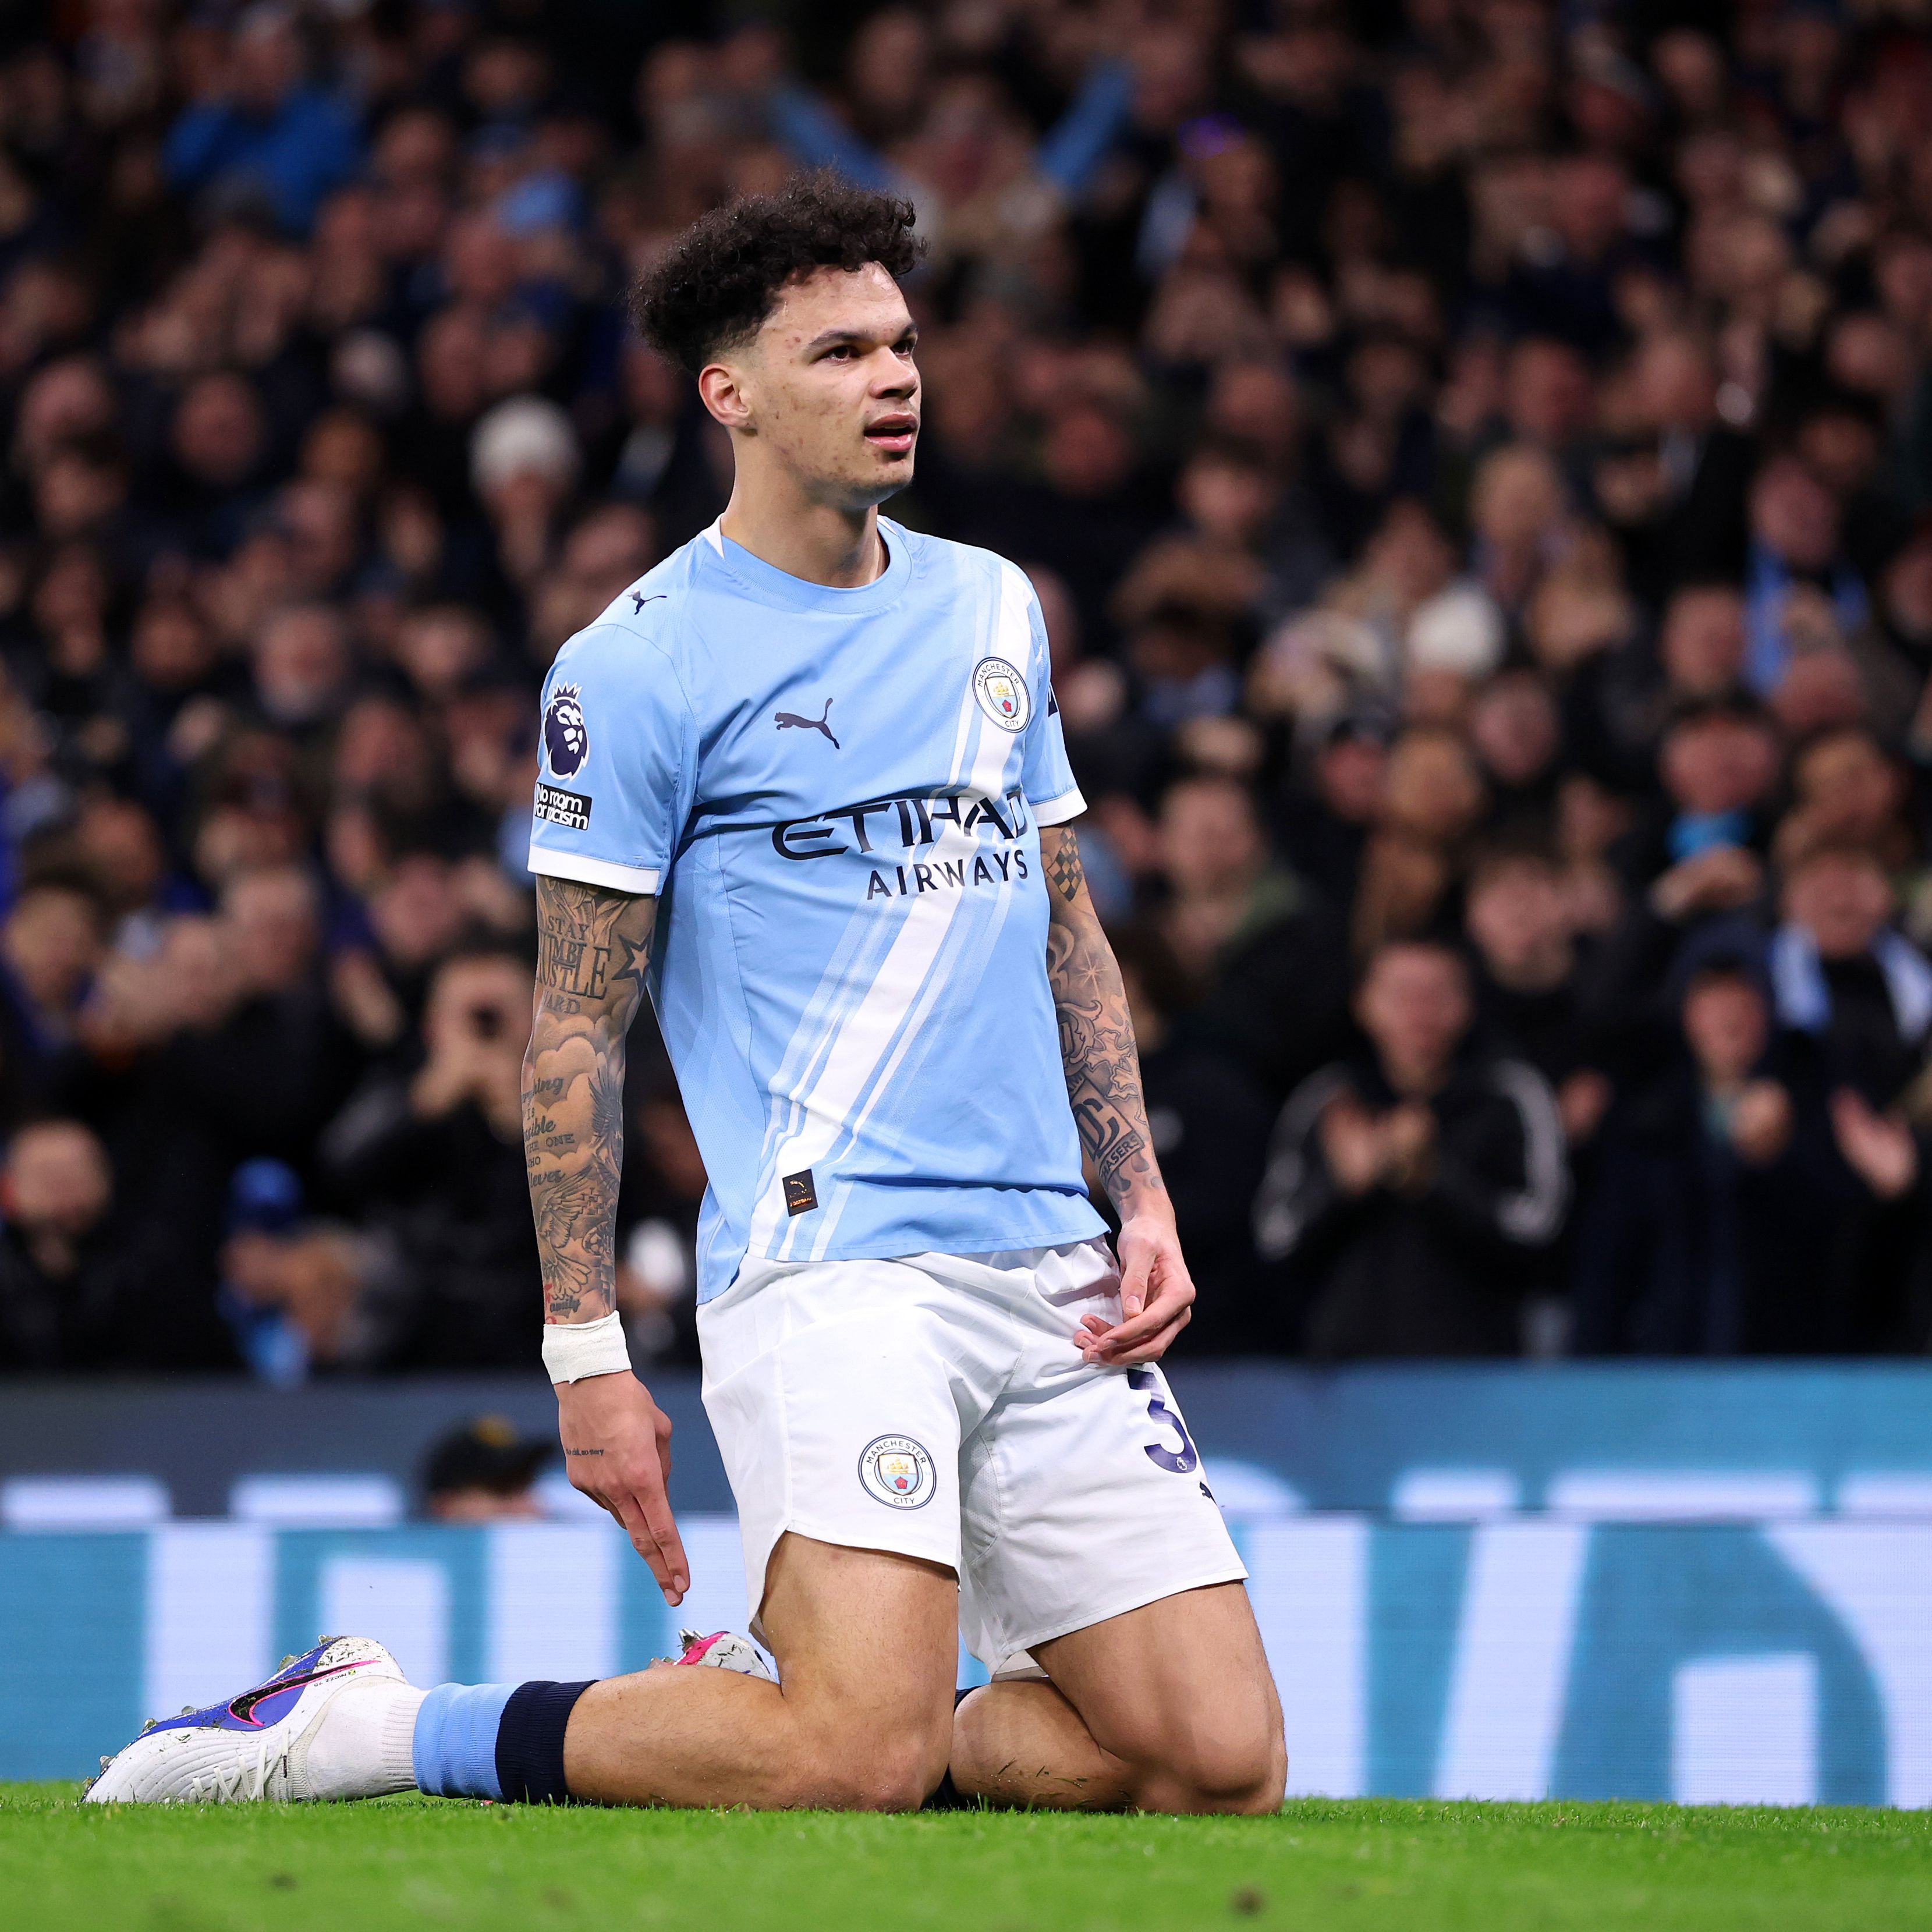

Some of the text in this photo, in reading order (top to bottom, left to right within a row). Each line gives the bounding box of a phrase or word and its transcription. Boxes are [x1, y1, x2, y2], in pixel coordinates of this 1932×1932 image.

[977, 663, 1020, 687] MANCHESTER
[537, 783, 583, 813] No room
[546, 806, 589, 830] racism
[772, 788, 1029, 860] ETIHAD
[867, 850, 1028, 900] AIRWAYS
[548, 915, 589, 941] STAY
[546, 1133, 575, 1147] ONE
[866, 1440, 926, 1464] MANCHESTER
